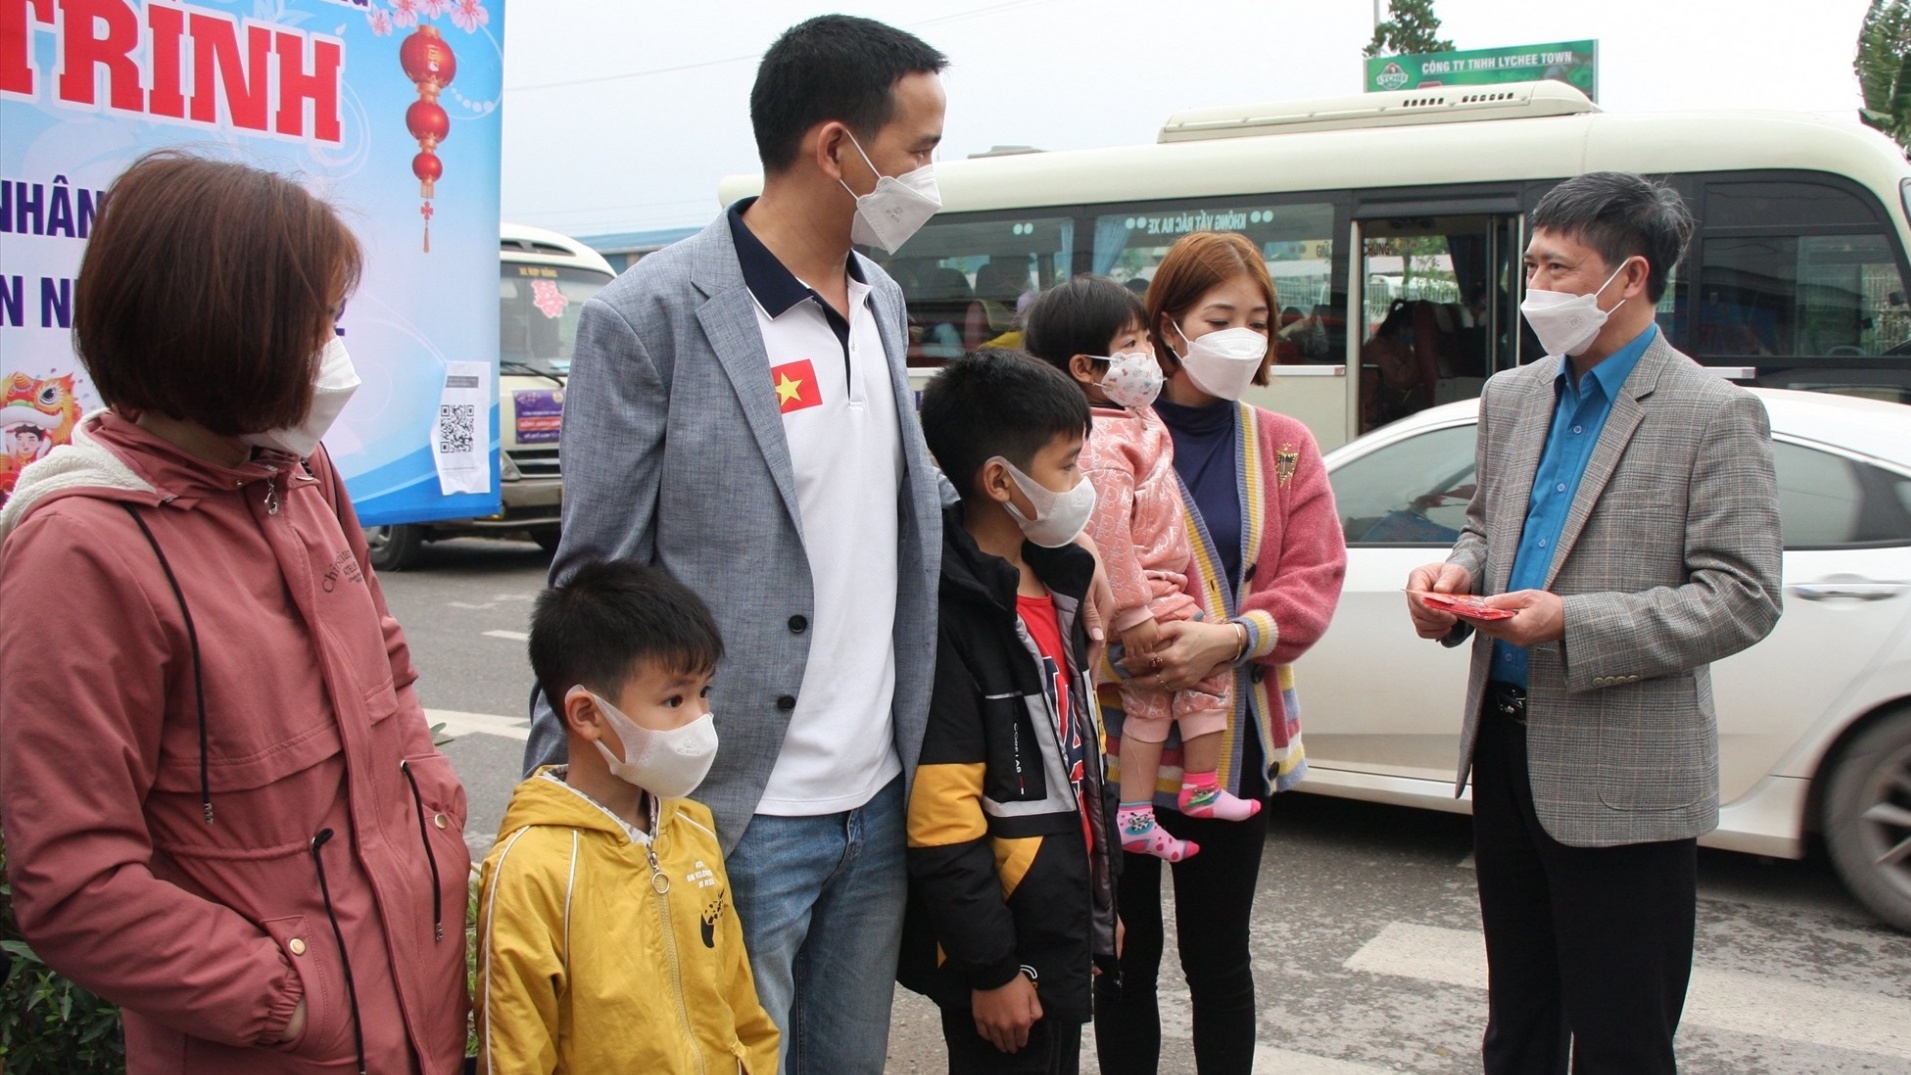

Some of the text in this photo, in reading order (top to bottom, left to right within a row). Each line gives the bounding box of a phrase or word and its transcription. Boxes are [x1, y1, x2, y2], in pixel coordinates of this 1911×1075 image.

[1422, 51, 1573, 75] CÔNG TY TNHH LYCHEE TOWN
